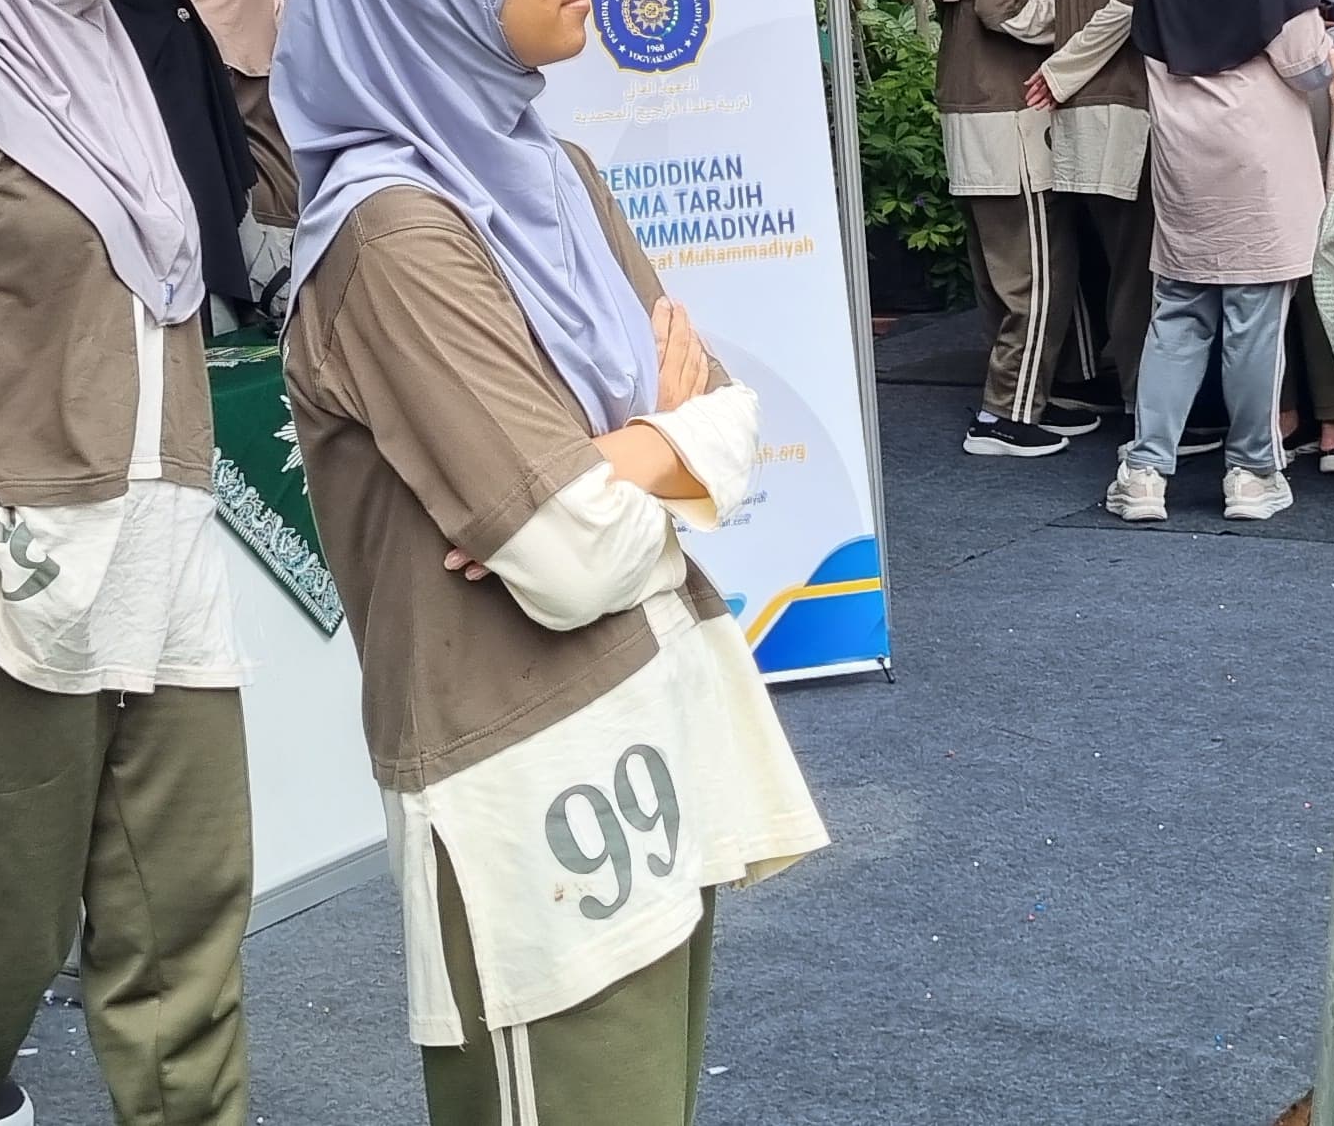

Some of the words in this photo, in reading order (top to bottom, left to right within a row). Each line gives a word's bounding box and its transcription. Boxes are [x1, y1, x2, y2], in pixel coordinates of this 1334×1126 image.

[645, 43, 665, 54] 1968
[675, 182, 764, 215] TARJIH
[636, 208, 796, 248] MMMADIYAH
[678, 235, 815, 268] Muhammadiyah
[545, 744, 680, 920] 99
